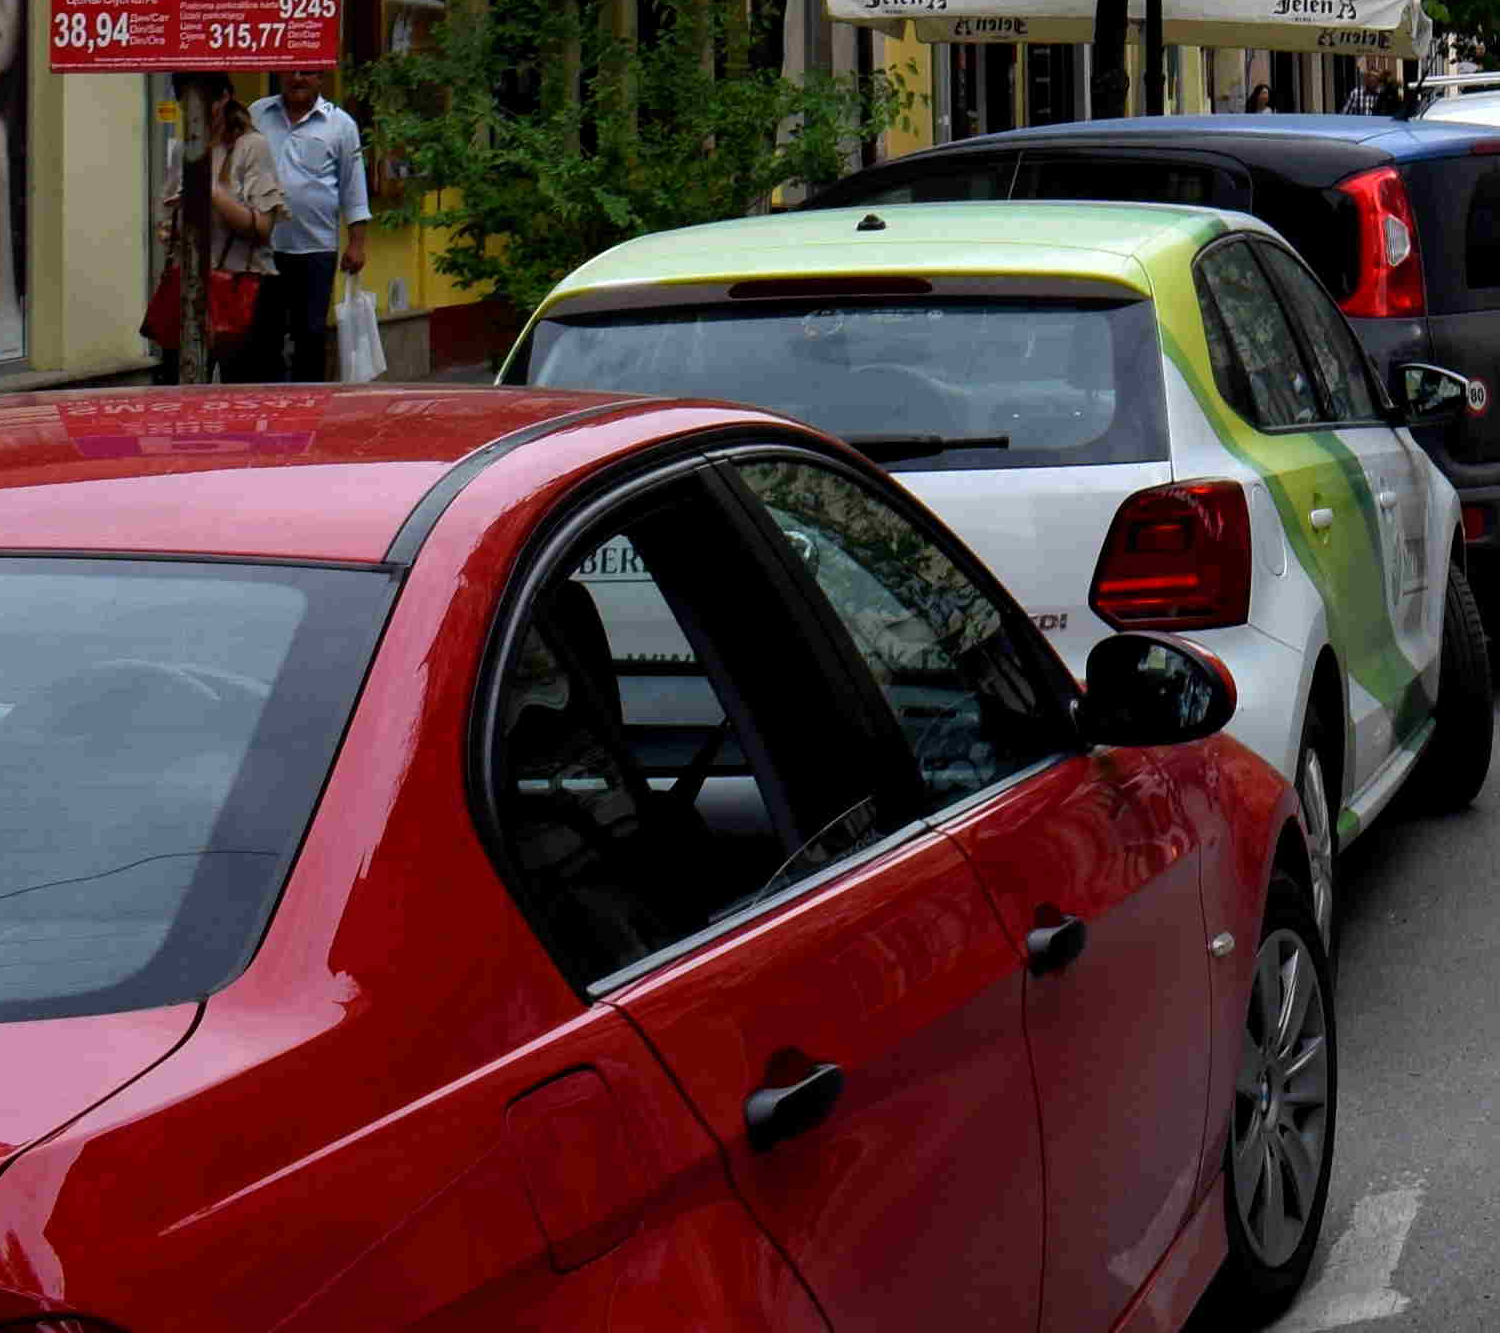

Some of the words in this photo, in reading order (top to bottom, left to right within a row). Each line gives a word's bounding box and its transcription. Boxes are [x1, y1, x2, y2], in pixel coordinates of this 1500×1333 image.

[54, 12, 130, 53] 38,94
[209, 22, 287, 52] 315,77
[1469, 387, 1485, 404] 80
